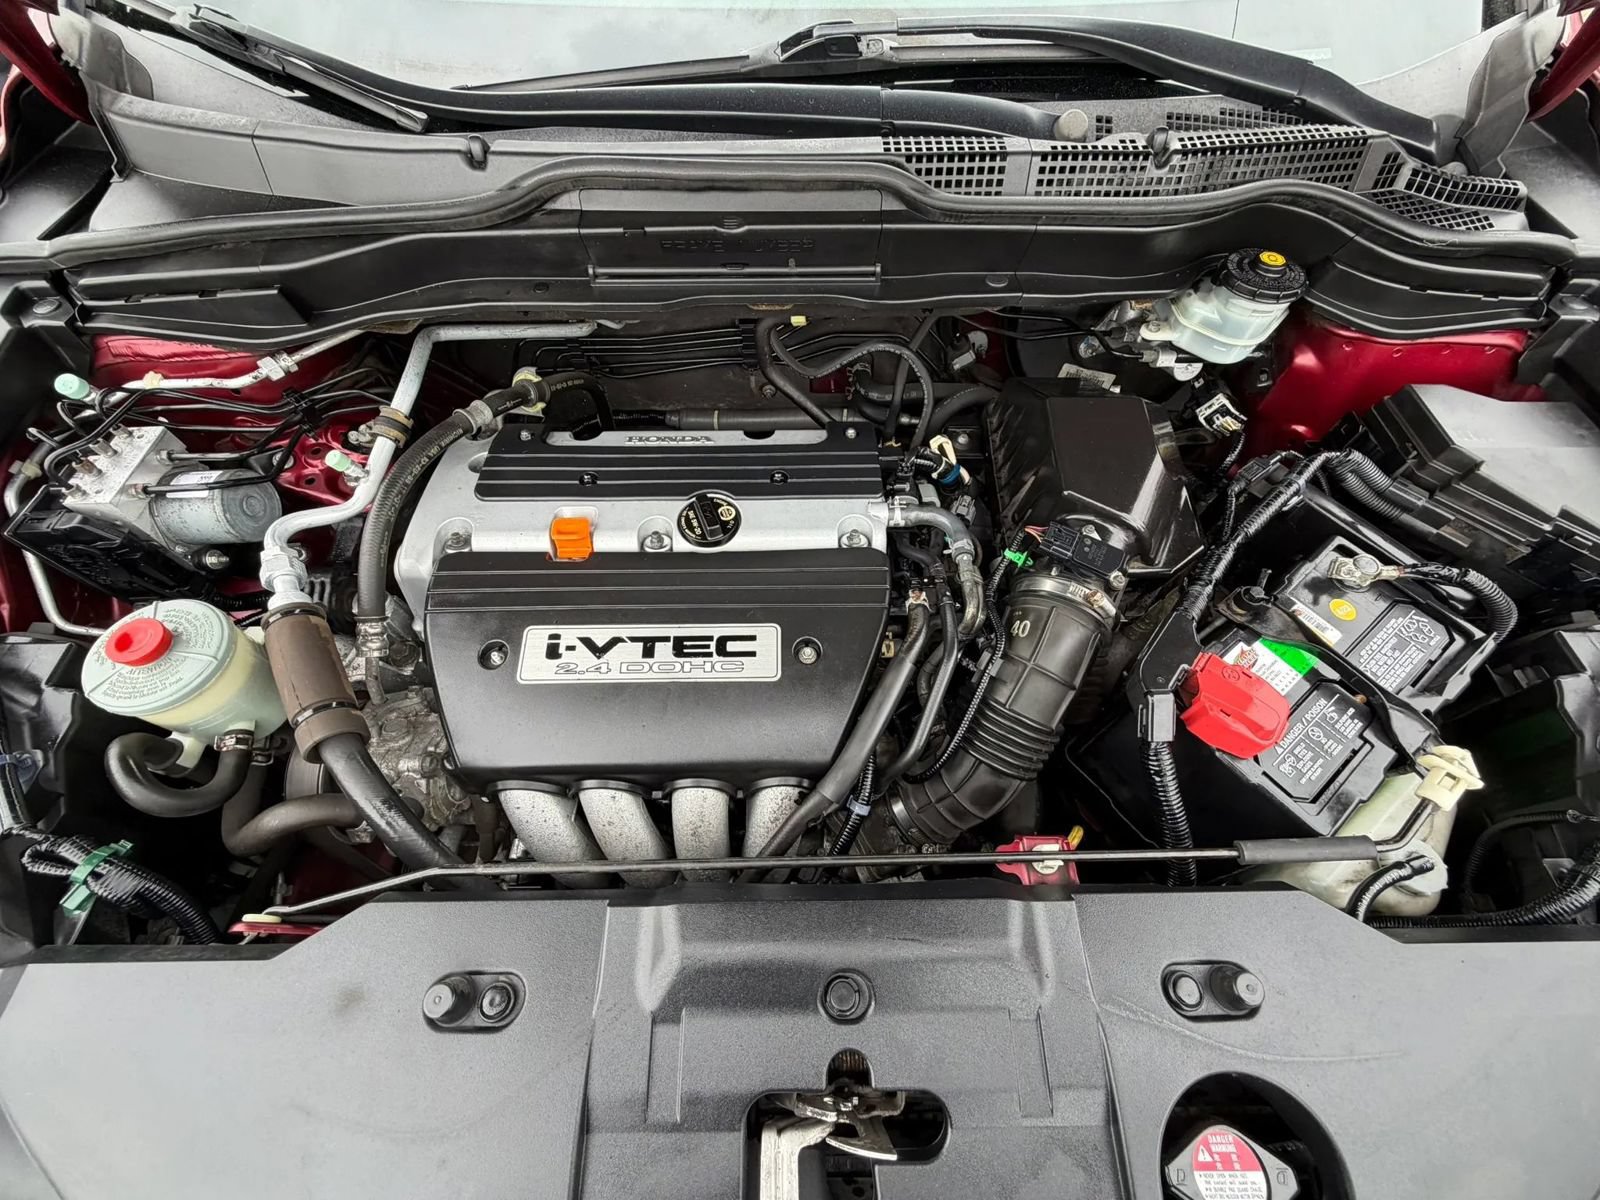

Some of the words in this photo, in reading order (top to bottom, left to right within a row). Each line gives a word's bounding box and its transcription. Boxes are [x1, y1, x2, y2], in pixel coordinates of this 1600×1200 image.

[625, 436, 715, 445] HONDA
[1010, 620, 1031, 637] 40
[545, 633, 757, 659] i-VTEC
[555, 661, 612, 674] 2.4
[619, 661, 744, 673] DOHC
[1281, 723, 1304, 748] DANGER
[1305, 698, 1328, 721] POISON
